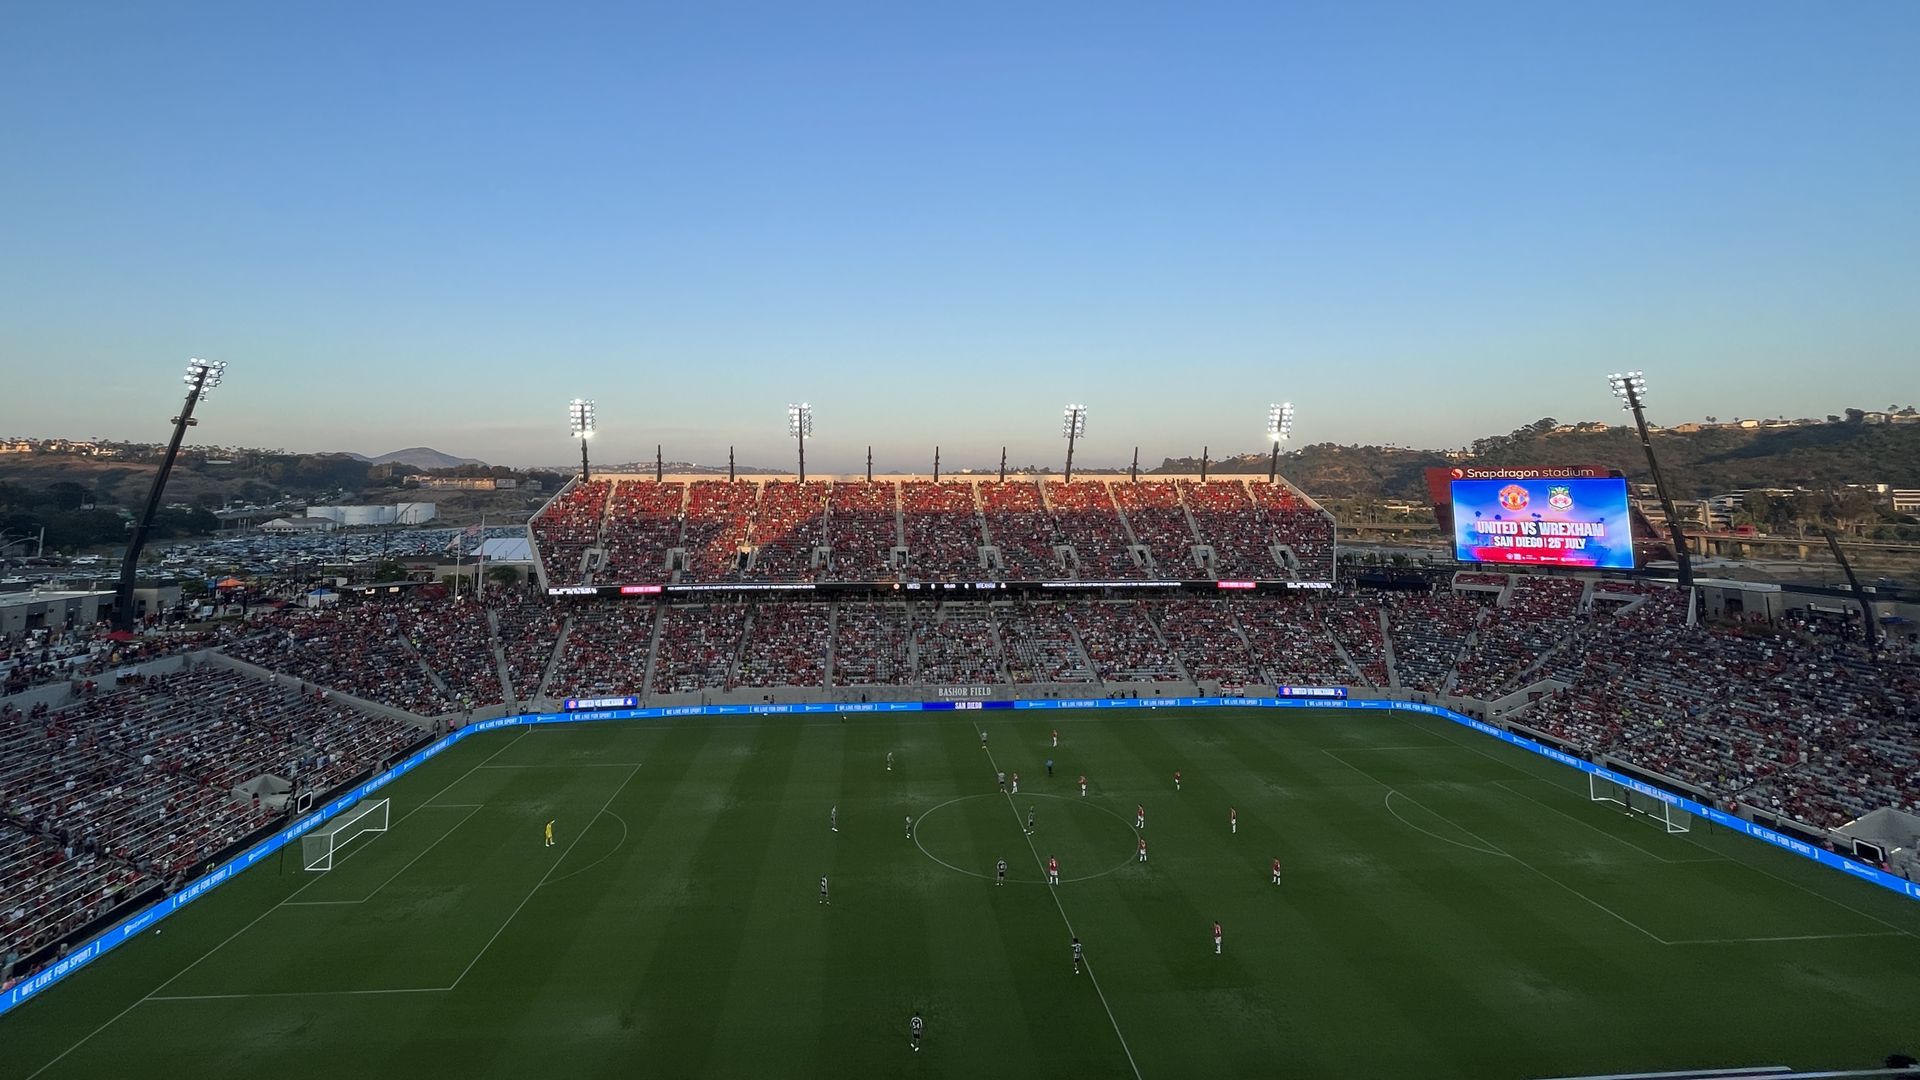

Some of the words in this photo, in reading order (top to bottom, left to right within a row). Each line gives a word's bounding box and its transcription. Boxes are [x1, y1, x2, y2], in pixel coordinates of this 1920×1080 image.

[1467, 468, 1538, 479] Snapdragon
[1542, 467, 1594, 477] stadium
[1477, 521, 1518, 534] UNITED
[1520, 522, 1536, 535] VS
[1539, 522, 1604, 536] WREXHAM
[1494, 536, 1513, 547] SAN
[1516, 537, 1542, 548] DIEGO
[1565, 538, 1586, 549] JULY
[938, 687, 968, 696] BASHOR
[970, 687, 991, 696] FIELD
[967, 701, 982, 709] DIEGO
[1752, 827, 1762, 837] WE
[1763, 831, 1776, 842] LIVE
[1777, 836, 1790, 847] FOR
[1790, 840, 1810, 854] SPORT
[179, 891, 188, 903] WE
[188, 884, 200, 898] LIVE
[201, 878, 210, 890] FOR
[211, 869, 227, 885] SPORT
[21, 980, 34, 996] WE
[35, 969, 53, 988] LIVE
[54, 960, 69, 977] FOR
[69, 947, 93, 968] SPORT
